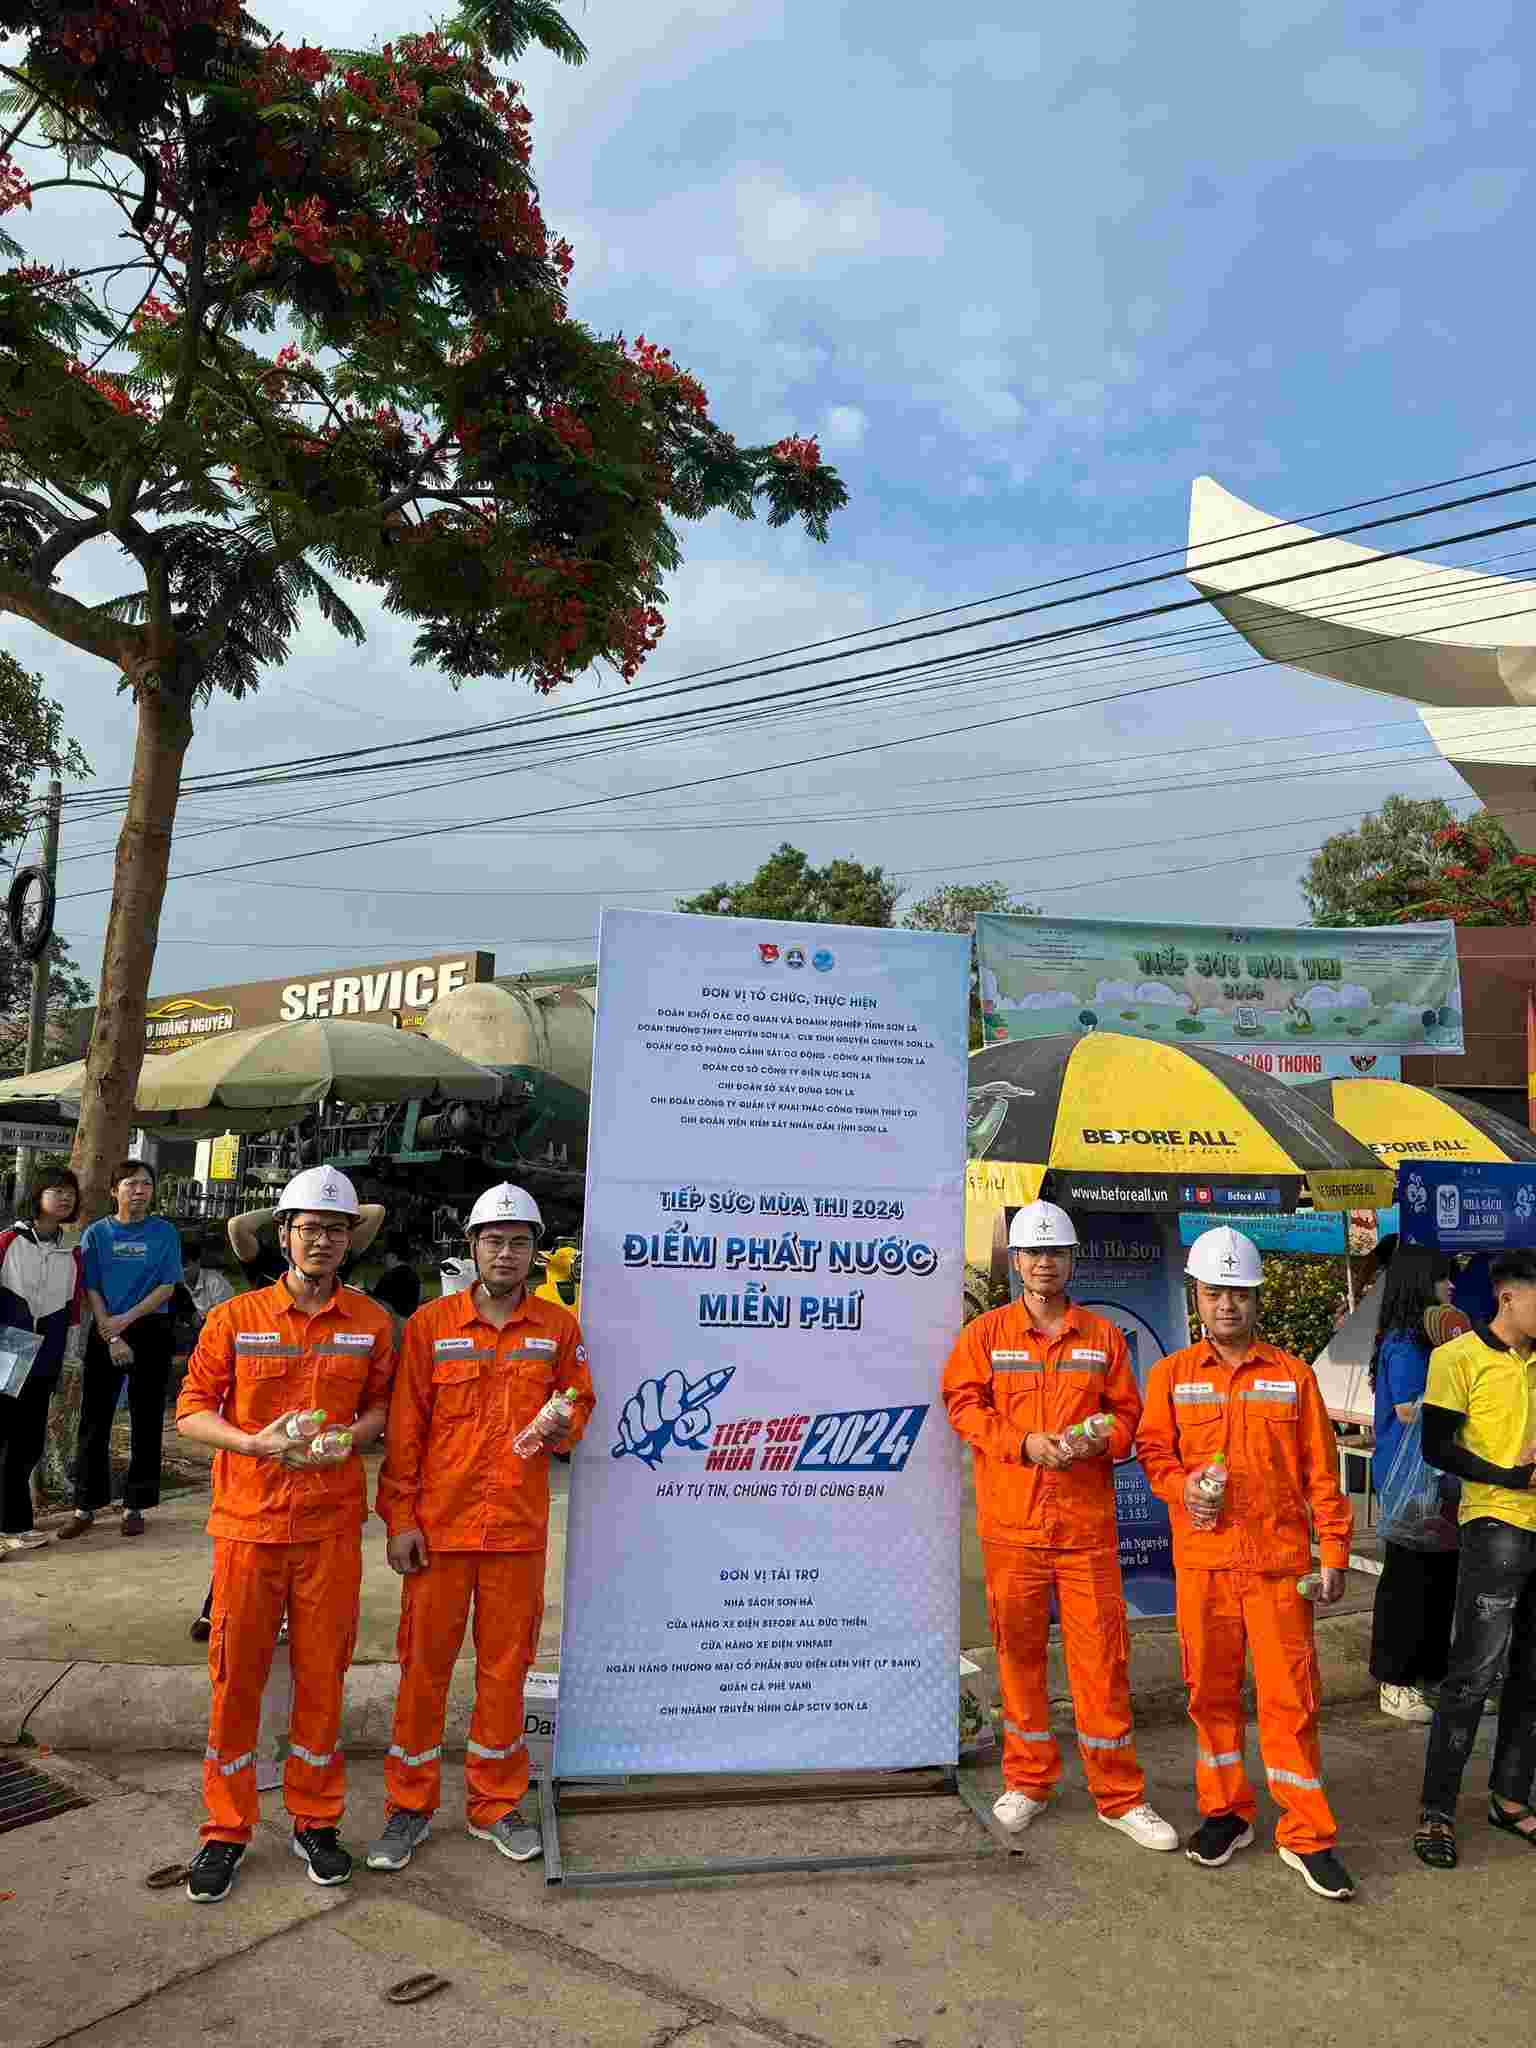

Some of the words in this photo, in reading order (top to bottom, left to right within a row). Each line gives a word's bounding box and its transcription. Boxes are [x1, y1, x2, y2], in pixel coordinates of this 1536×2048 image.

[280, 961, 467, 1021] SERVICE
[1082, 1128, 1185, 1145] BEFORE
[1188, 1130, 1237, 1146] ALL
[1366, 1142, 1433, 1154] EFORE
[1433, 1139, 1469, 1151] ALL
[659, 1184, 705, 1213] TIẾP
[708, 1190, 755, 1214] SỨC
[760, 1192, 809, 1216] MÙA
[815, 1196, 848, 1218] THI
[851, 1199, 905, 1220] 2024
[1071, 1187, 1168, 1202] www.beforeall.vn
[623, 1220, 717, 1269] ĐIỂM
[725, 1231, 822, 1272] PHÁT
[828, 1237, 938, 1276] NƯỚC
[699, 1281, 791, 1328] MIỄN
[799, 1290, 865, 1330] PHÍ
[713, 1417, 762, 1446] TIẾP
[763, 1411, 811, 1444] SỨC
[802, 1407, 914, 1466] 2024
[705, 1443, 755, 1472] MÙA
[759, 1446, 798, 1472] THI
[656, 1481, 683, 1496] HÃY
[686, 1483, 702, 1500] TỰ
[707, 1484, 729, 1499] TIN,
[733, 1481, 777, 1497] CHÚNG
[780, 1481, 802, 1496] TÔI
[804, 1483, 817, 1496] ĐI
[820, 1480, 856, 1497] CÙNG
[858, 1484, 885, 1503] BẠN
[719, 1569, 749, 1581] ĐƠN
[754, 1569, 766, 1584] VỊ
[770, 1567, 790, 1581] TÀI
[795, 1567, 819, 1583] TRỢ
